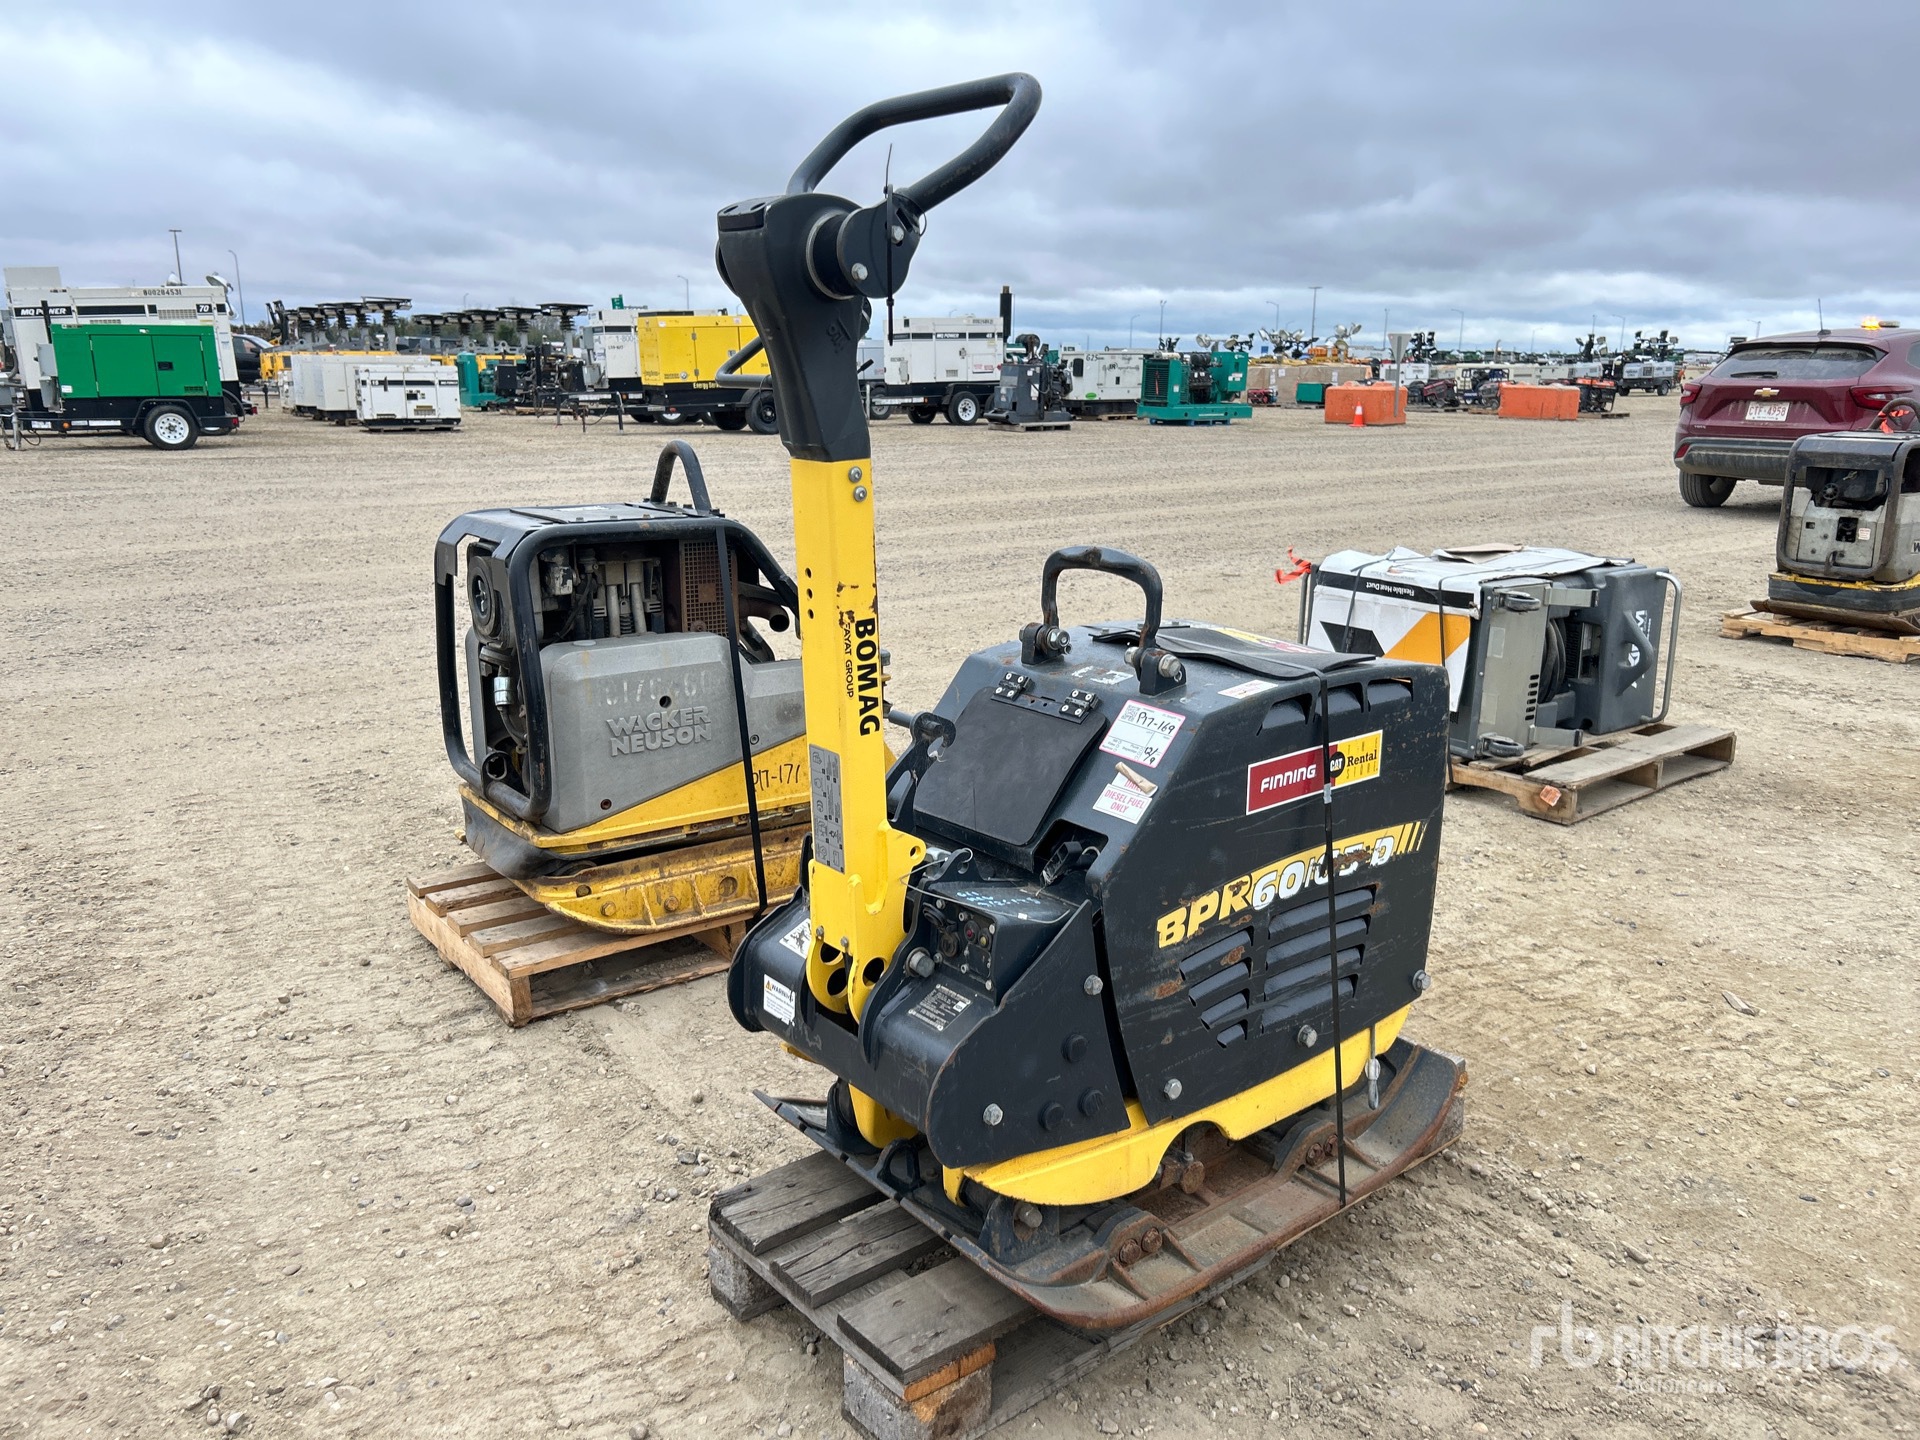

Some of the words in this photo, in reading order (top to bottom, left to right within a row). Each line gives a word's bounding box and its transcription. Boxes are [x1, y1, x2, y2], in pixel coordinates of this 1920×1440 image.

[1366, 581, 1380, 591] Duct
[1392, 586, 1415, 597] Flexible
[843, 622, 853, 656] FAYAT
[845, 659, 854, 698] GROUP
[855, 617, 881, 737] BOMAG
[606, 705, 712, 737] WACKER
[610, 724, 713, 757] NEUSON
[1330, 758, 1343, 772] CAT
[1346, 749, 1378, 768] Rental
[1260, 764, 1317, 793] FINNING
[1104, 789, 1127, 805] DIESEL
[1127, 797, 1146, 809] FUEL
[1110, 802, 1130, 814] ONLY
